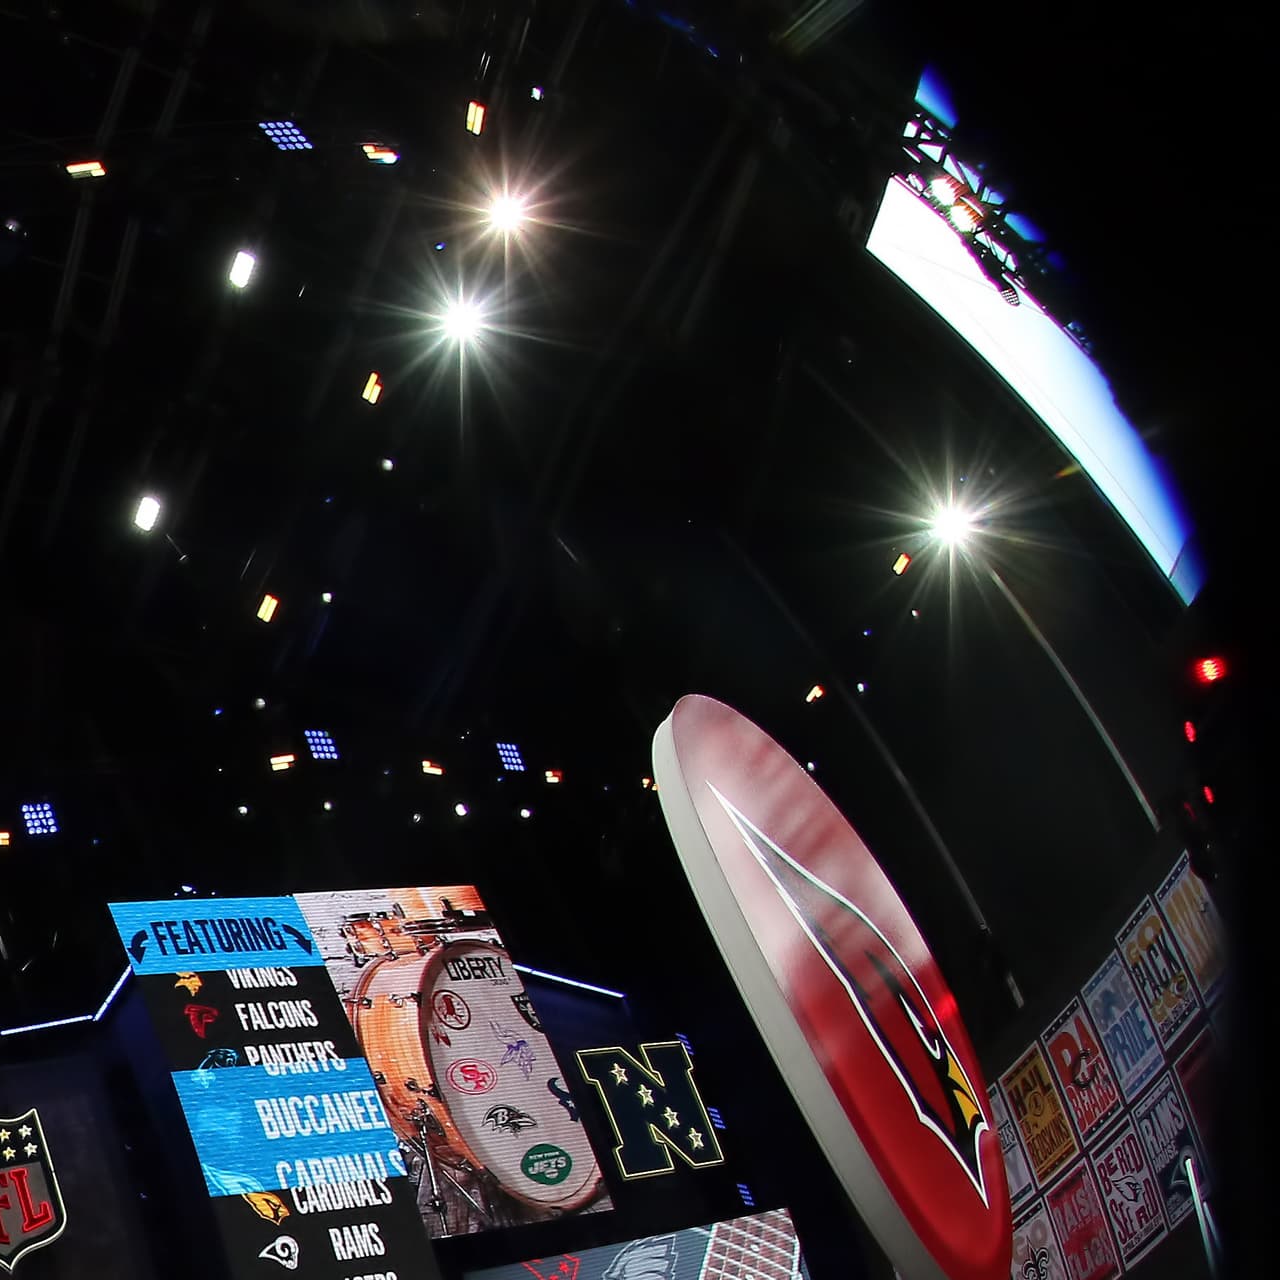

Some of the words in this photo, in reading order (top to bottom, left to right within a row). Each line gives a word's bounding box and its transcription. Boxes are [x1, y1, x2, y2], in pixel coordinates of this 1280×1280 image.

[150, 917, 286, 956] FEATURING
[1126, 915, 1163, 966] GO
[226, 966, 298, 990] VIKINGS
[445, 956, 507, 982] LIBERTY
[1130, 932, 1182, 1009] PACK
[234, 1000, 319, 1031] FALCONS
[1104, 1001, 1155, 1080] PRIDE
[255, 1088, 388, 1141] BUCCANEE
[576, 1041, 726, 1181] N
[1007, 1065, 1053, 1121] HAIL
[1025, 1111, 1072, 1170] REDSKINS
[1140, 1090, 1186, 1158] RAMS
[1097, 1155, 1119, 1198] BE
[1115, 1133, 1145, 1175] RED
[293, 1177, 393, 1215] CARDINALS
[1109, 1198, 1138, 1246] SEE
[1135, 1177, 1161, 1229] RED
[328, 1222, 386, 1262] RAMS
